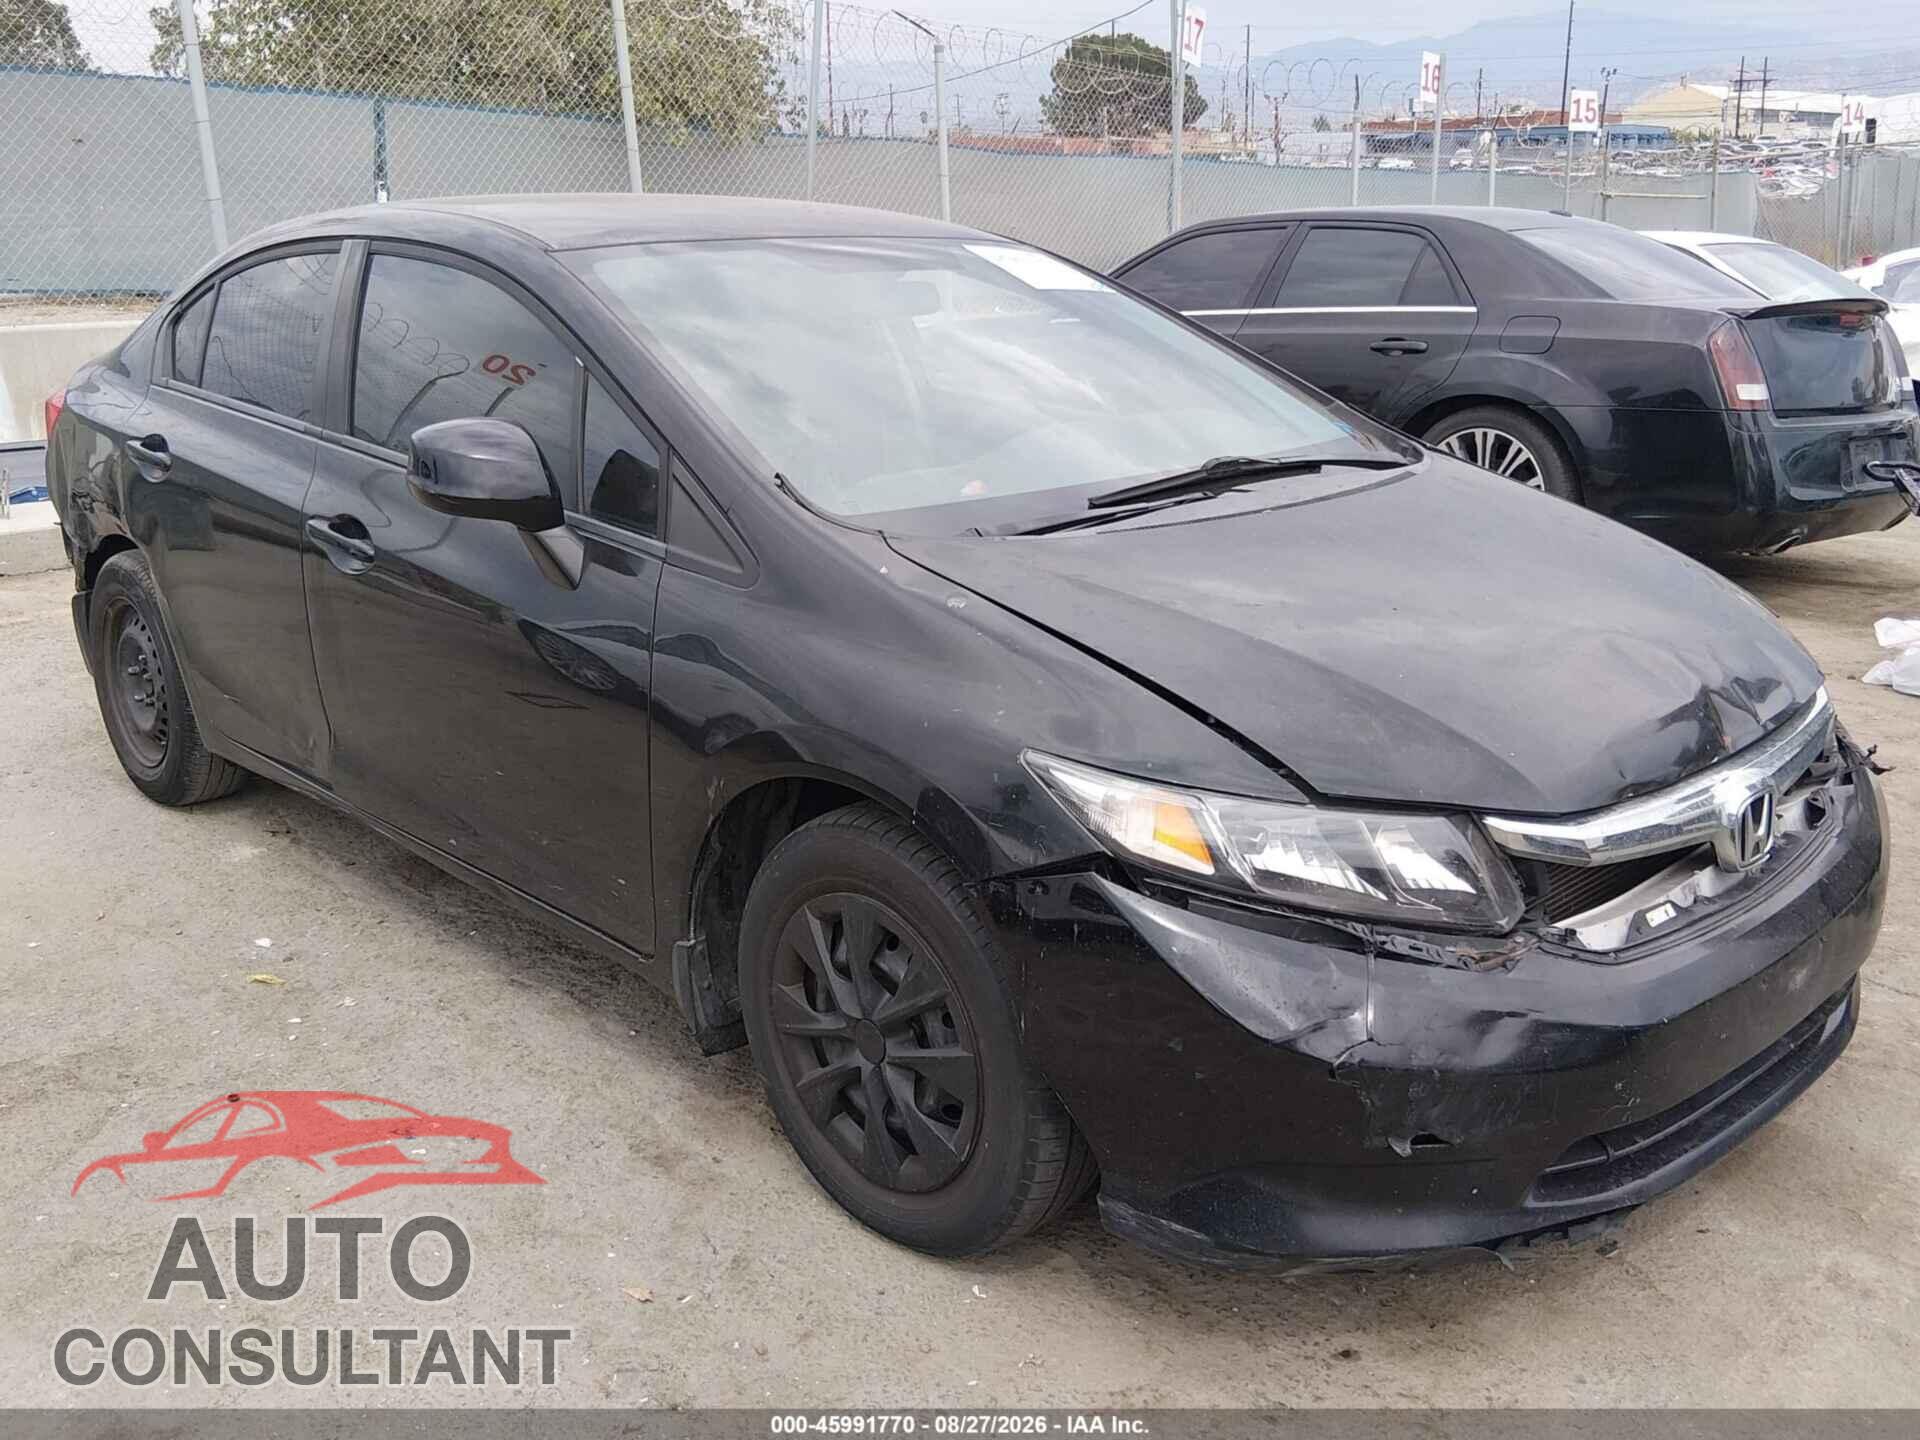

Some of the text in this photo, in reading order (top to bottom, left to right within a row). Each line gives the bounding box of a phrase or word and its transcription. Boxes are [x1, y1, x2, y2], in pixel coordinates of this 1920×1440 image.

[1184, 16, 1204, 56] 17
[1422, 62, 1441, 95] 16
[1571, 98, 1597, 123] 15
[1843, 102, 1865, 127] 14
